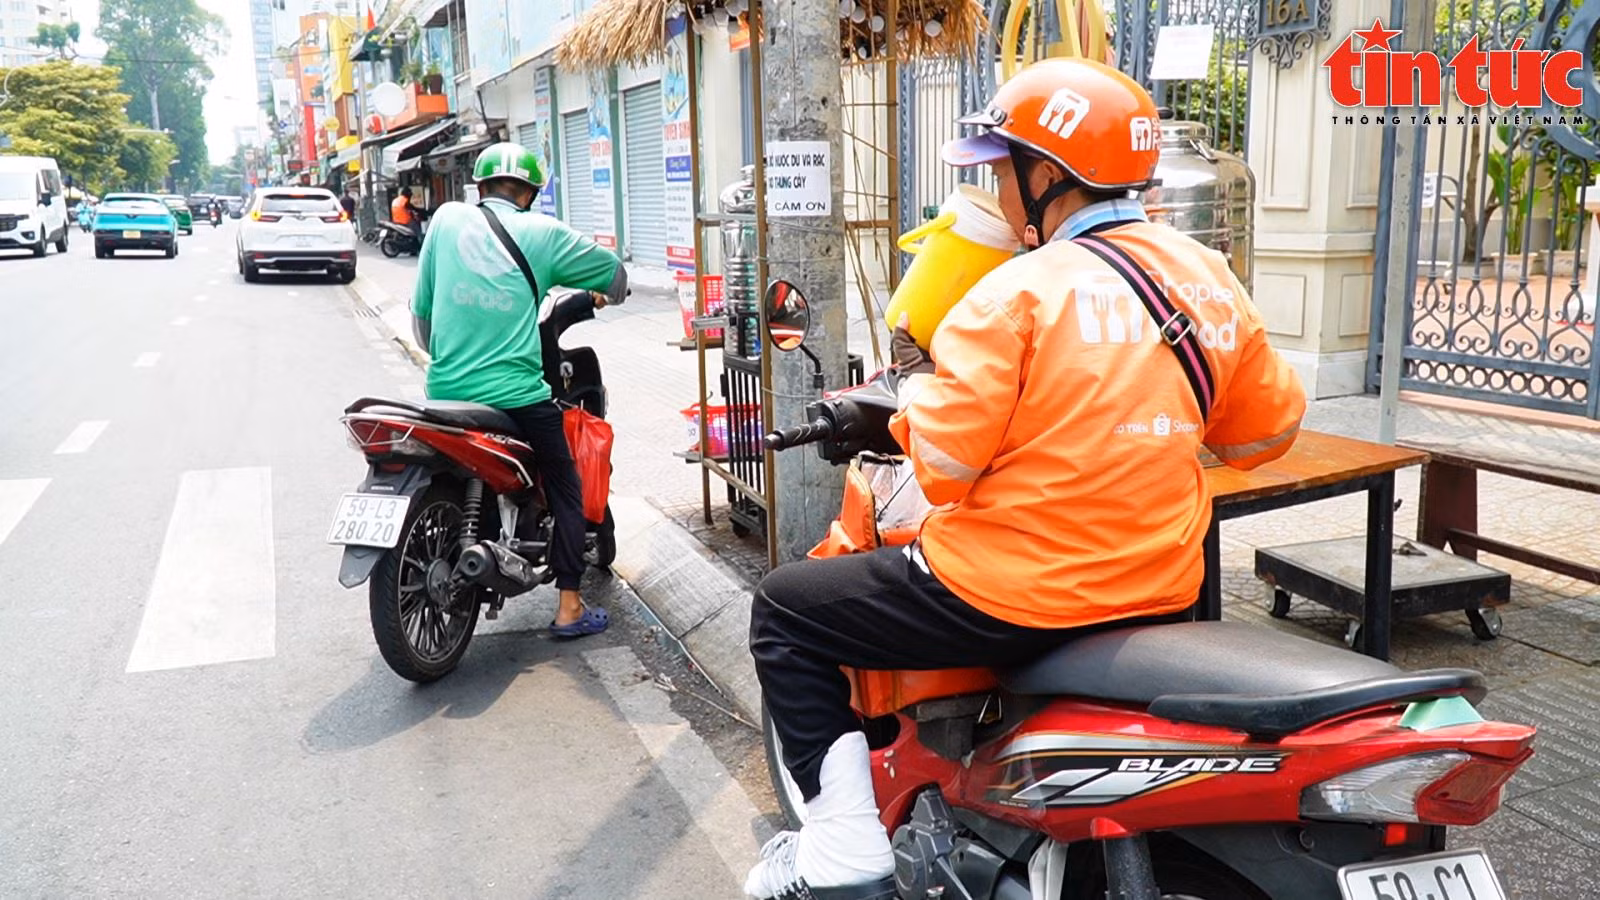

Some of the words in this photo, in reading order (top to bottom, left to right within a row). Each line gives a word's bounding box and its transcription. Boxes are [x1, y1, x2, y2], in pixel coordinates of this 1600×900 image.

[1266, 0, 1309, 27] 16A
[452, 282, 514, 311] Grab
[346, 498, 397, 519] 59-L3
[334, 520, 395, 543] 280.20
[1117, 757, 1282, 777] BLADE
